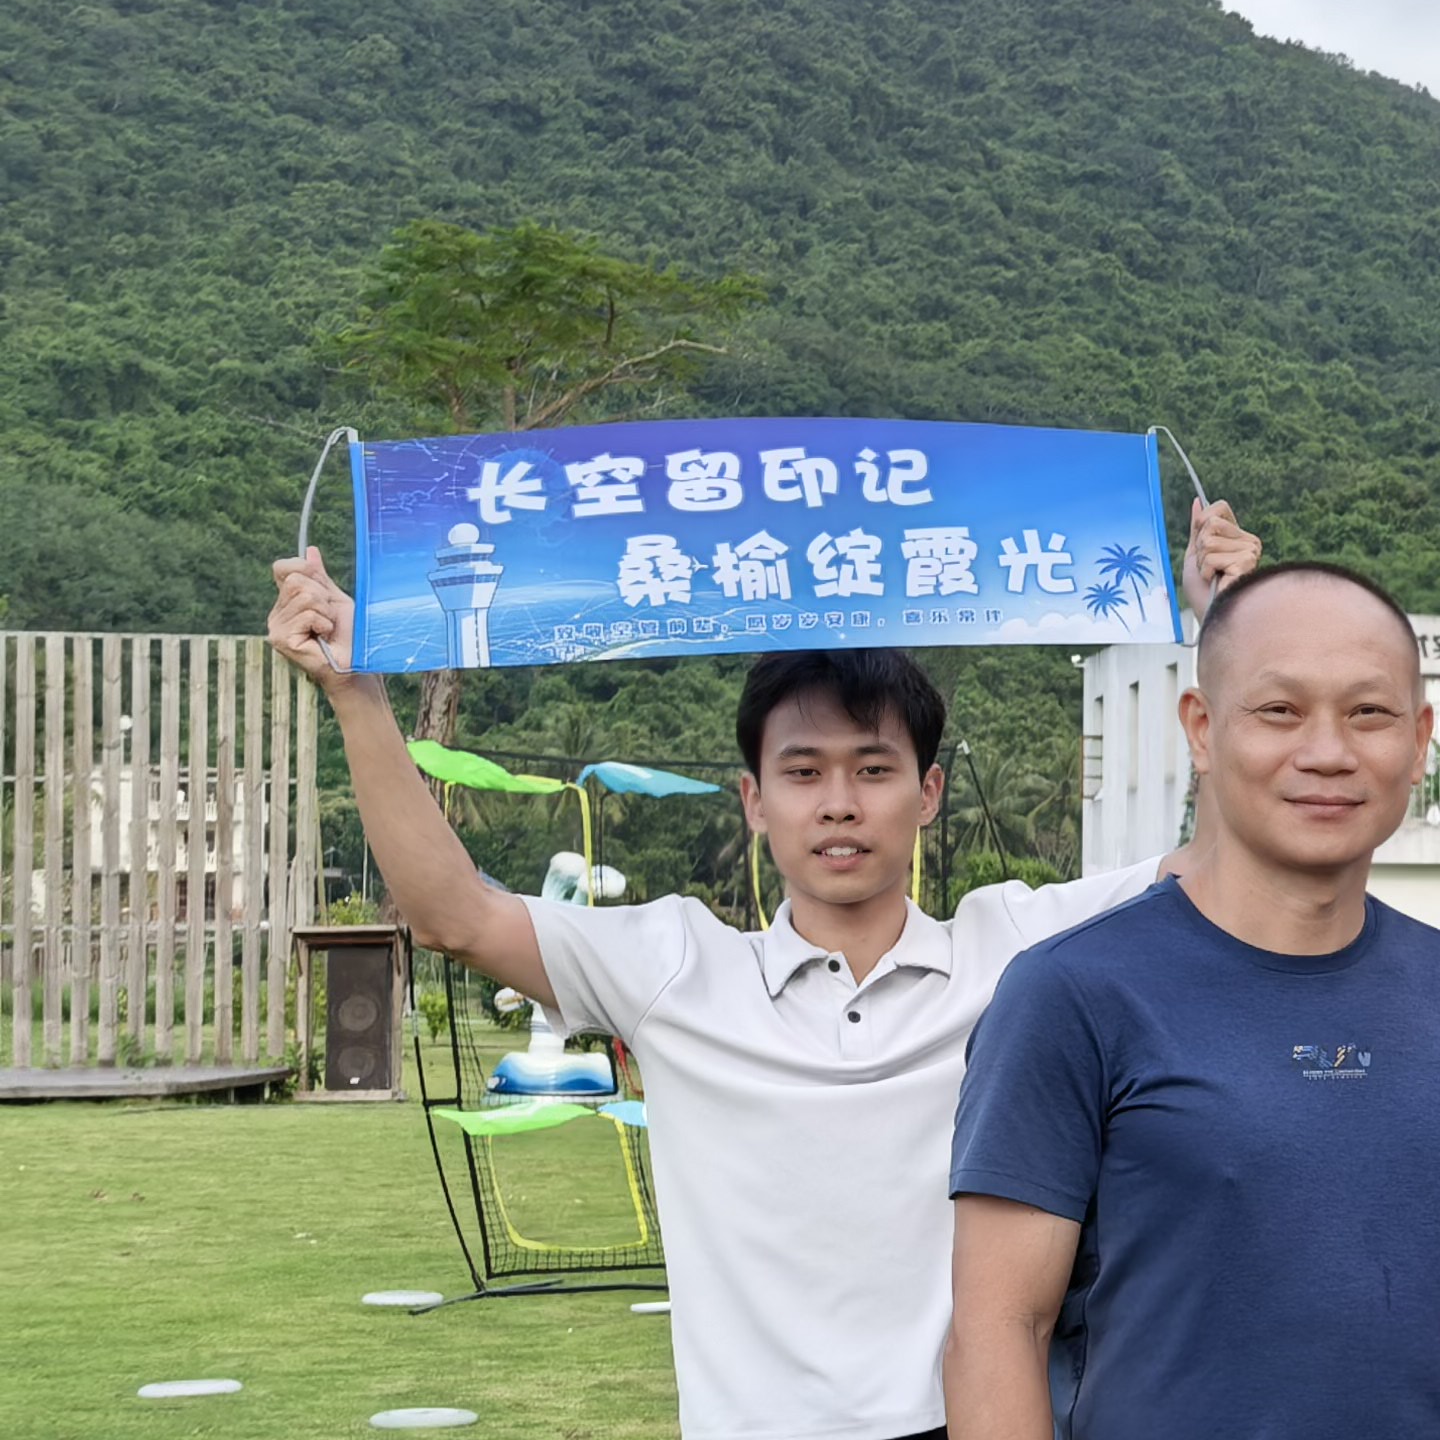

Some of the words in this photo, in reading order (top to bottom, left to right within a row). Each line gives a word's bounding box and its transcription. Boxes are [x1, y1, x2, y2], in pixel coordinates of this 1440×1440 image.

[467, 447, 934, 525] 长空留印记
[616, 525, 1077, 606] 桑榆绽霞光
